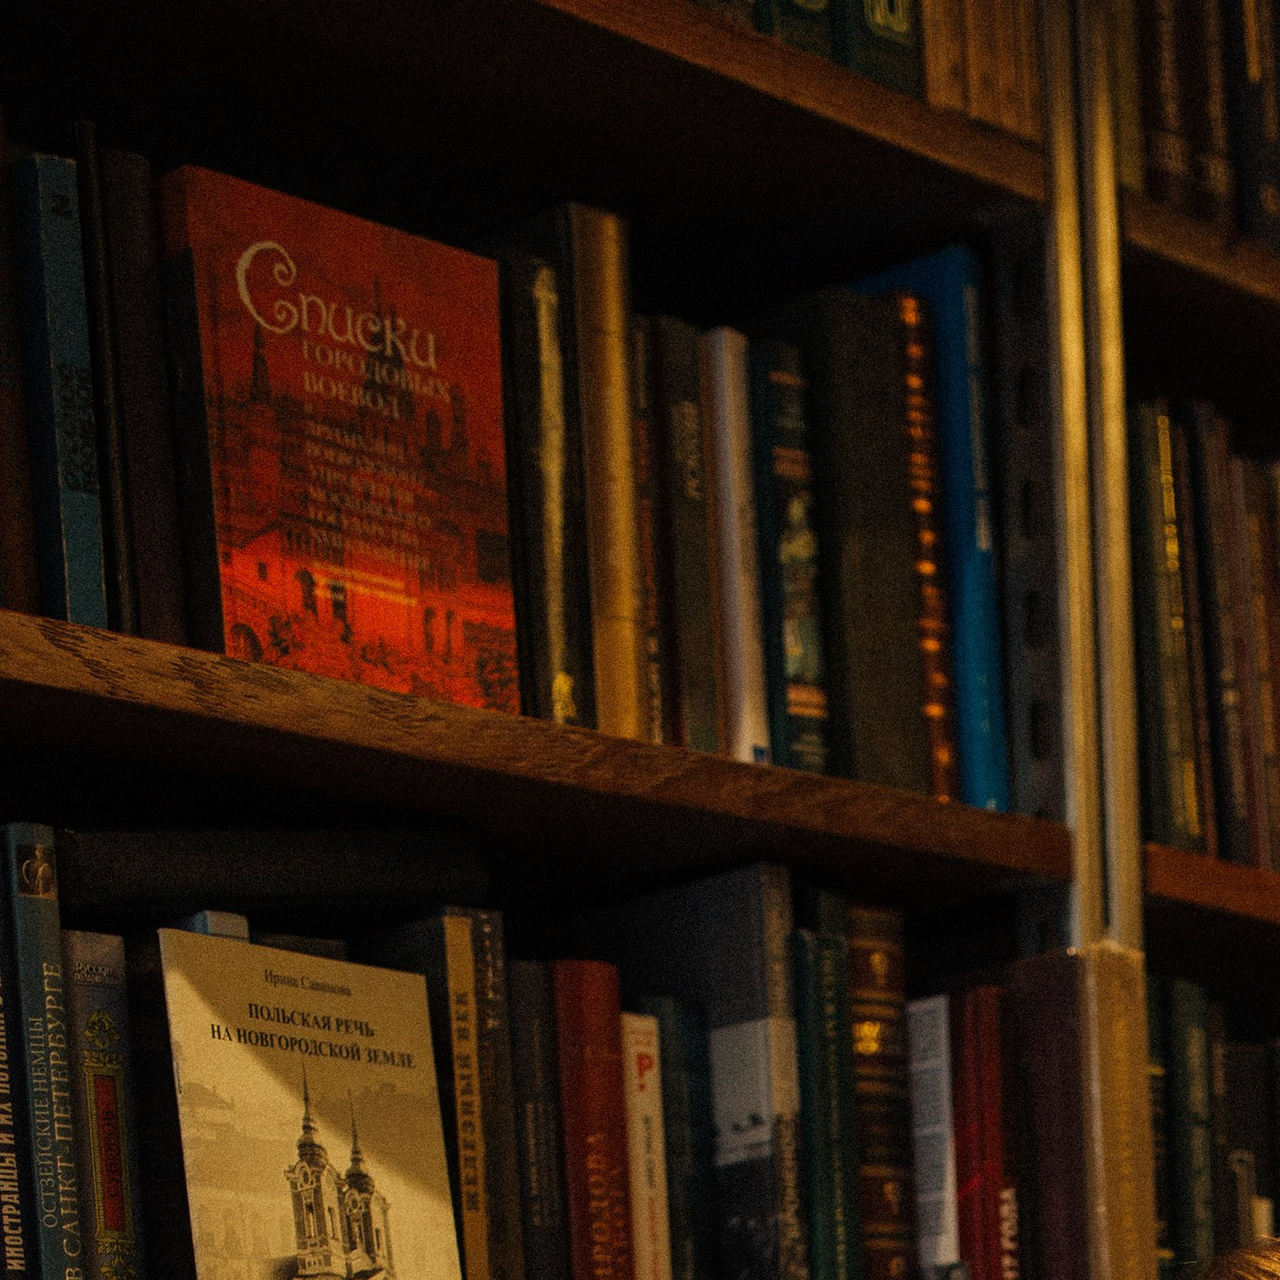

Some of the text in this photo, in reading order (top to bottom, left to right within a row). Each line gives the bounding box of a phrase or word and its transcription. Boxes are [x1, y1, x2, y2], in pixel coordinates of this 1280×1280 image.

[235, 238, 437, 371] Списки
[301, 338, 452, 403] ГОРОДОВЫХ
[302, 370, 401, 420] ВОЕВОД
[210, 1022, 417, 1070] НА НОВГОРОДСКОЙ ЗЕМЛЕ
[247, 1001, 376, 1039] ПОЛЬСКАЯ РЕЧЬ
[27, 1015, 60, 1229] ОСТЗЕЙСКИЕ НЕМЦЫ
[41, 960, 84, 1259] САНКТ-ПЕТЕРБУРГЕ
[454, 991, 480, 1212] ЖЕЛЕЗНЫЙ ВЕК
[0, 1150, 26, 1272] ИНОСТРАНЦЫ
